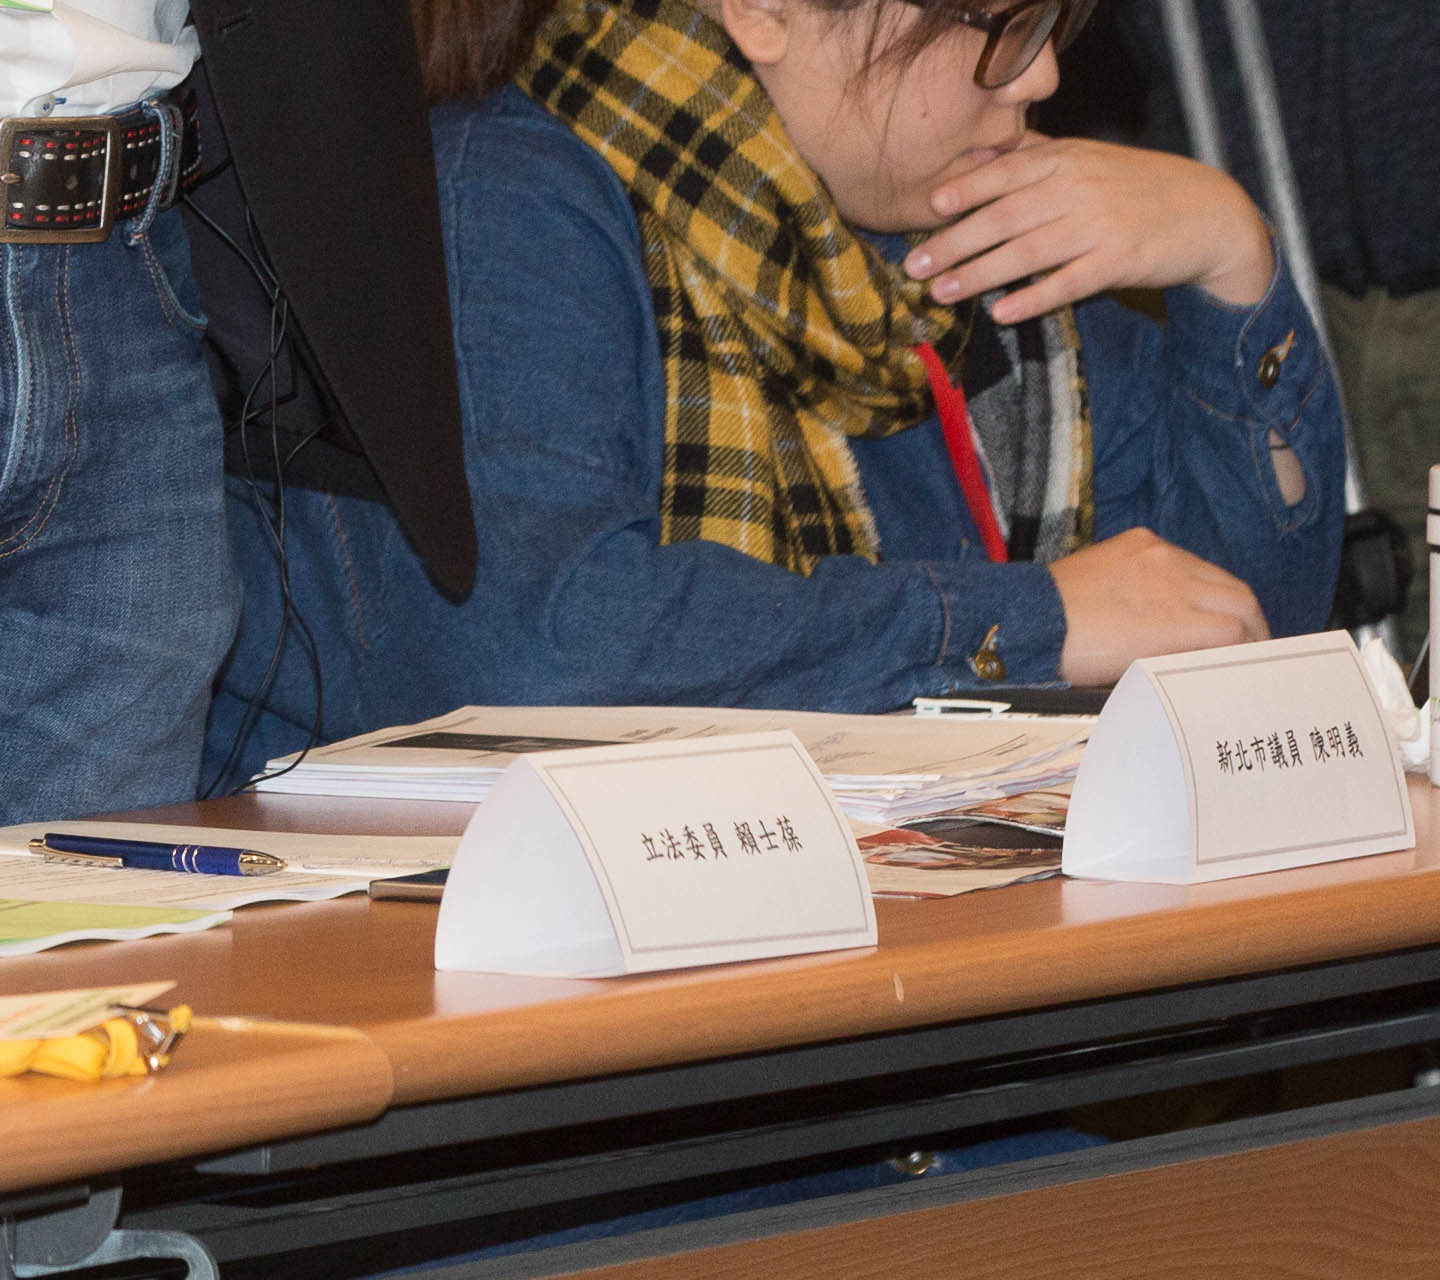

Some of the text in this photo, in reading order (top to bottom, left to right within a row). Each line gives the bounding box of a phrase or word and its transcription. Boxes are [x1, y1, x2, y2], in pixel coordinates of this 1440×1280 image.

[1216, 721, 1364, 776] 新北市議員 陳明義
[640, 815, 805, 862] 立法委員 賴士葆
